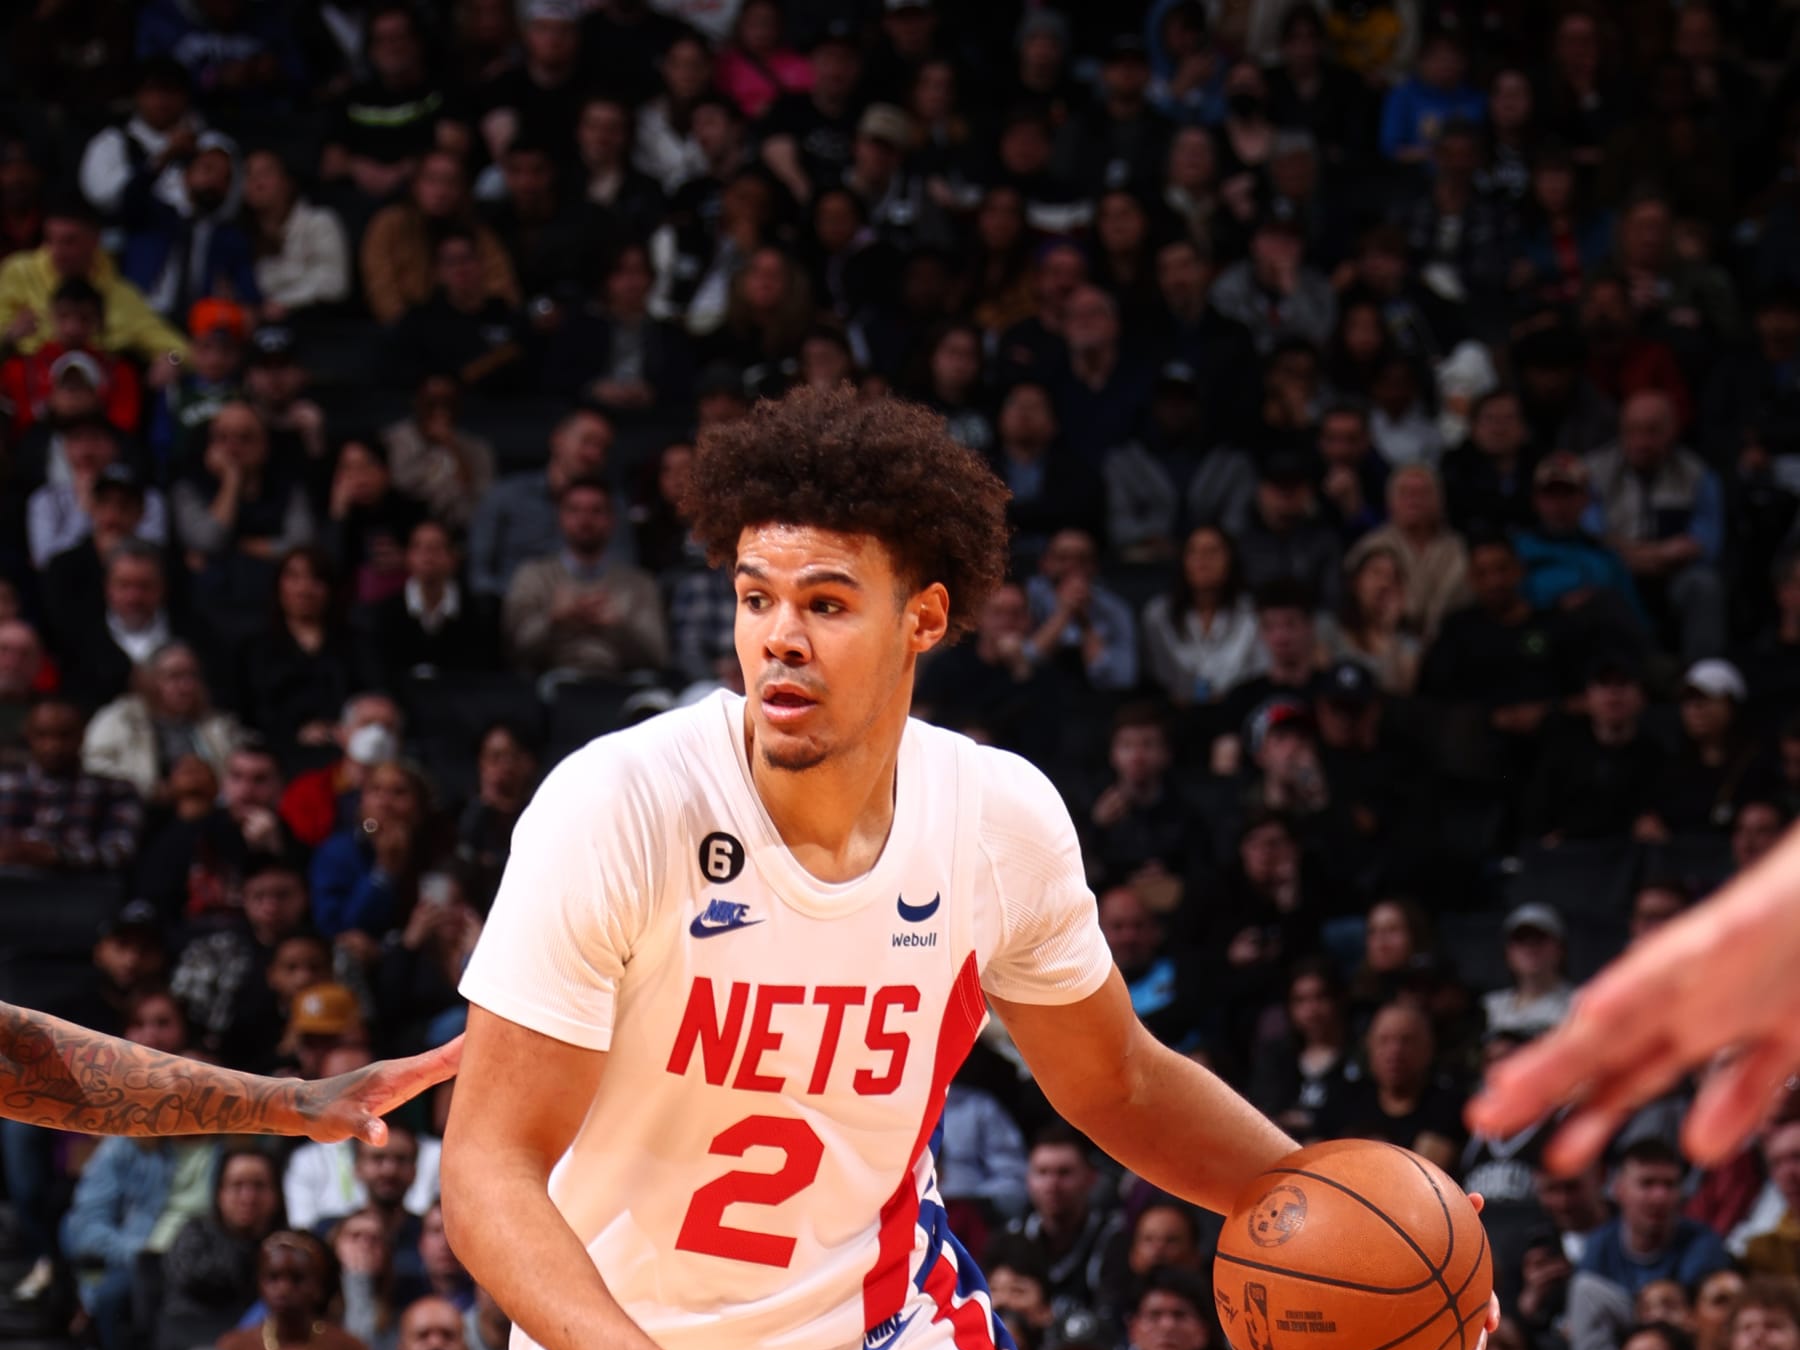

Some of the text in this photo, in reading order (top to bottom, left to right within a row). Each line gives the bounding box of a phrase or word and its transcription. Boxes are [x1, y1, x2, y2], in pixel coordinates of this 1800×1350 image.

[707, 839, 734, 879] 6
[703, 898, 751, 925] NIKE
[891, 932, 937, 947] Webull
[666, 976, 921, 1096] NETS
[674, 1114, 825, 1269] 2
[866, 1311, 903, 1346] NIKE
